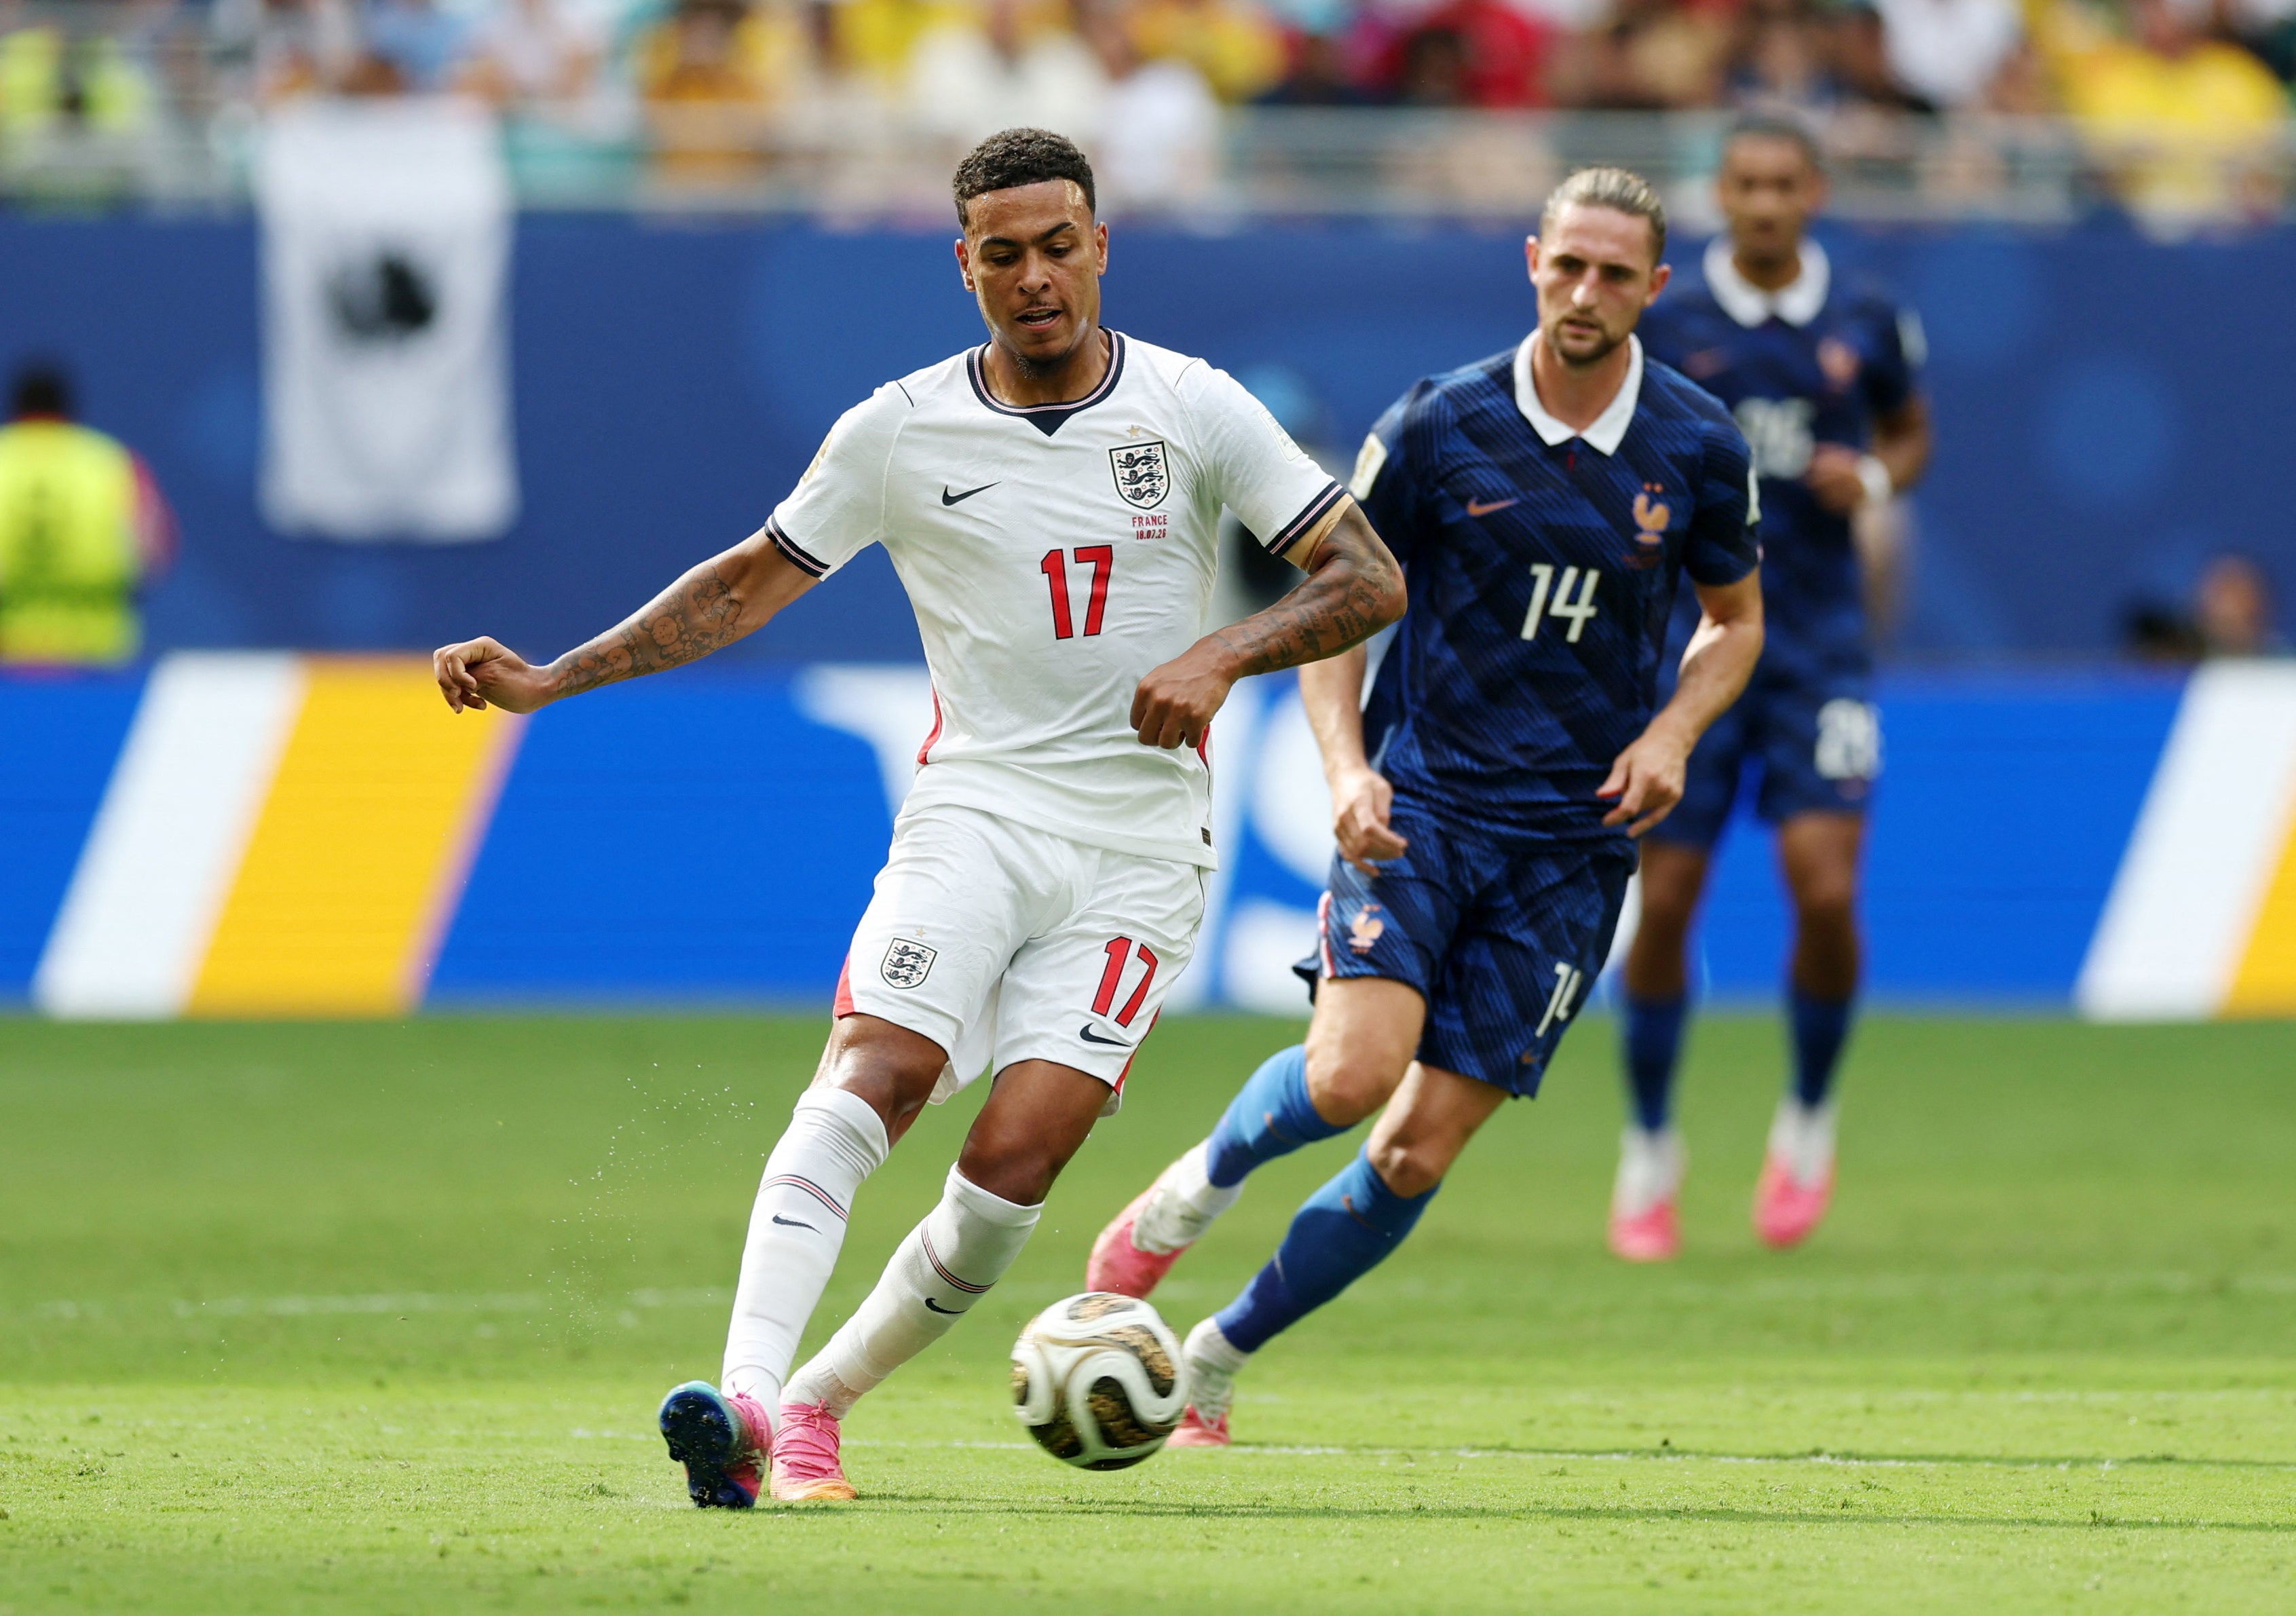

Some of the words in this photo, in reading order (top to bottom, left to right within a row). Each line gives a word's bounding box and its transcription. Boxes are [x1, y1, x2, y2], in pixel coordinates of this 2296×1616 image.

[1132, 515, 1167, 527] FRANCE
[1136, 529, 1166, 540] 18.07.26
[1041, 544, 1113, 640] 17
[1520, 563, 1600, 643] 14
[1091, 936, 1158, 1028] 17
